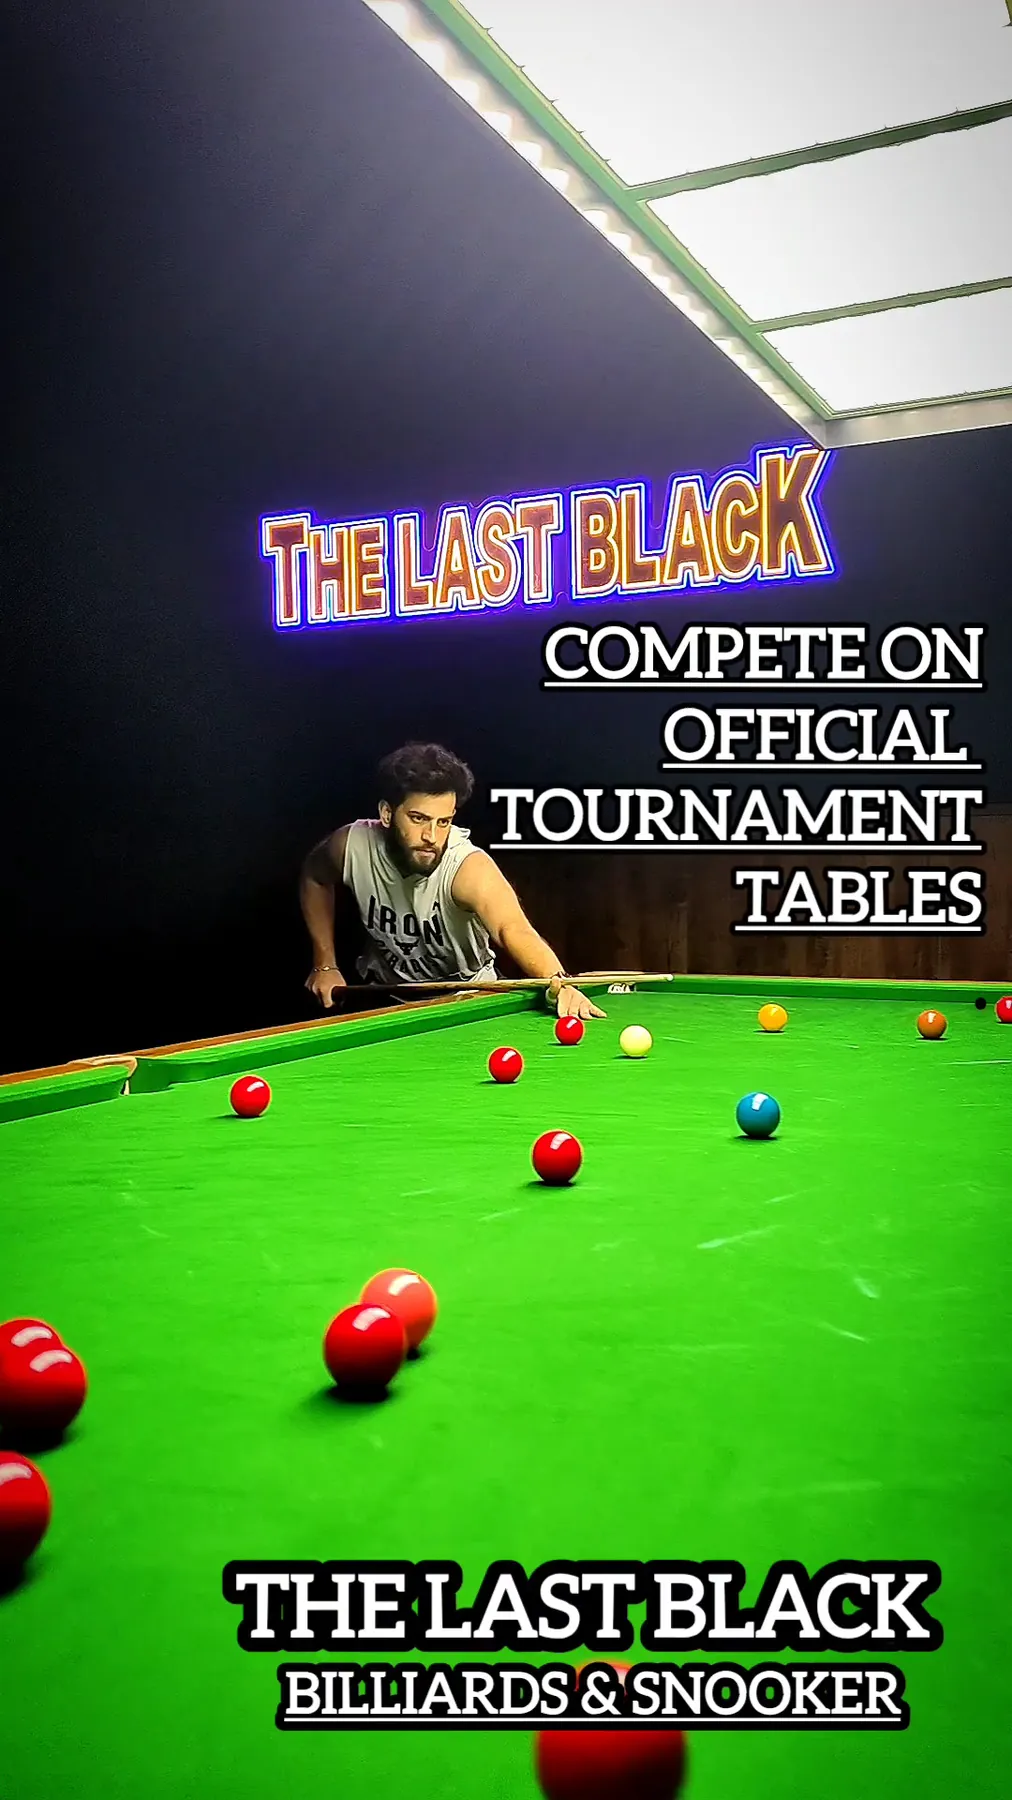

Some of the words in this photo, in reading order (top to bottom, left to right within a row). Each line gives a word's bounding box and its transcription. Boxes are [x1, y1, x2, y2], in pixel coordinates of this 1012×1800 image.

[263, 513, 390, 626] THE
[394, 493, 563, 617] LAST
[573, 444, 834, 599] BLACK
[367, 895, 444, 947] IRON
